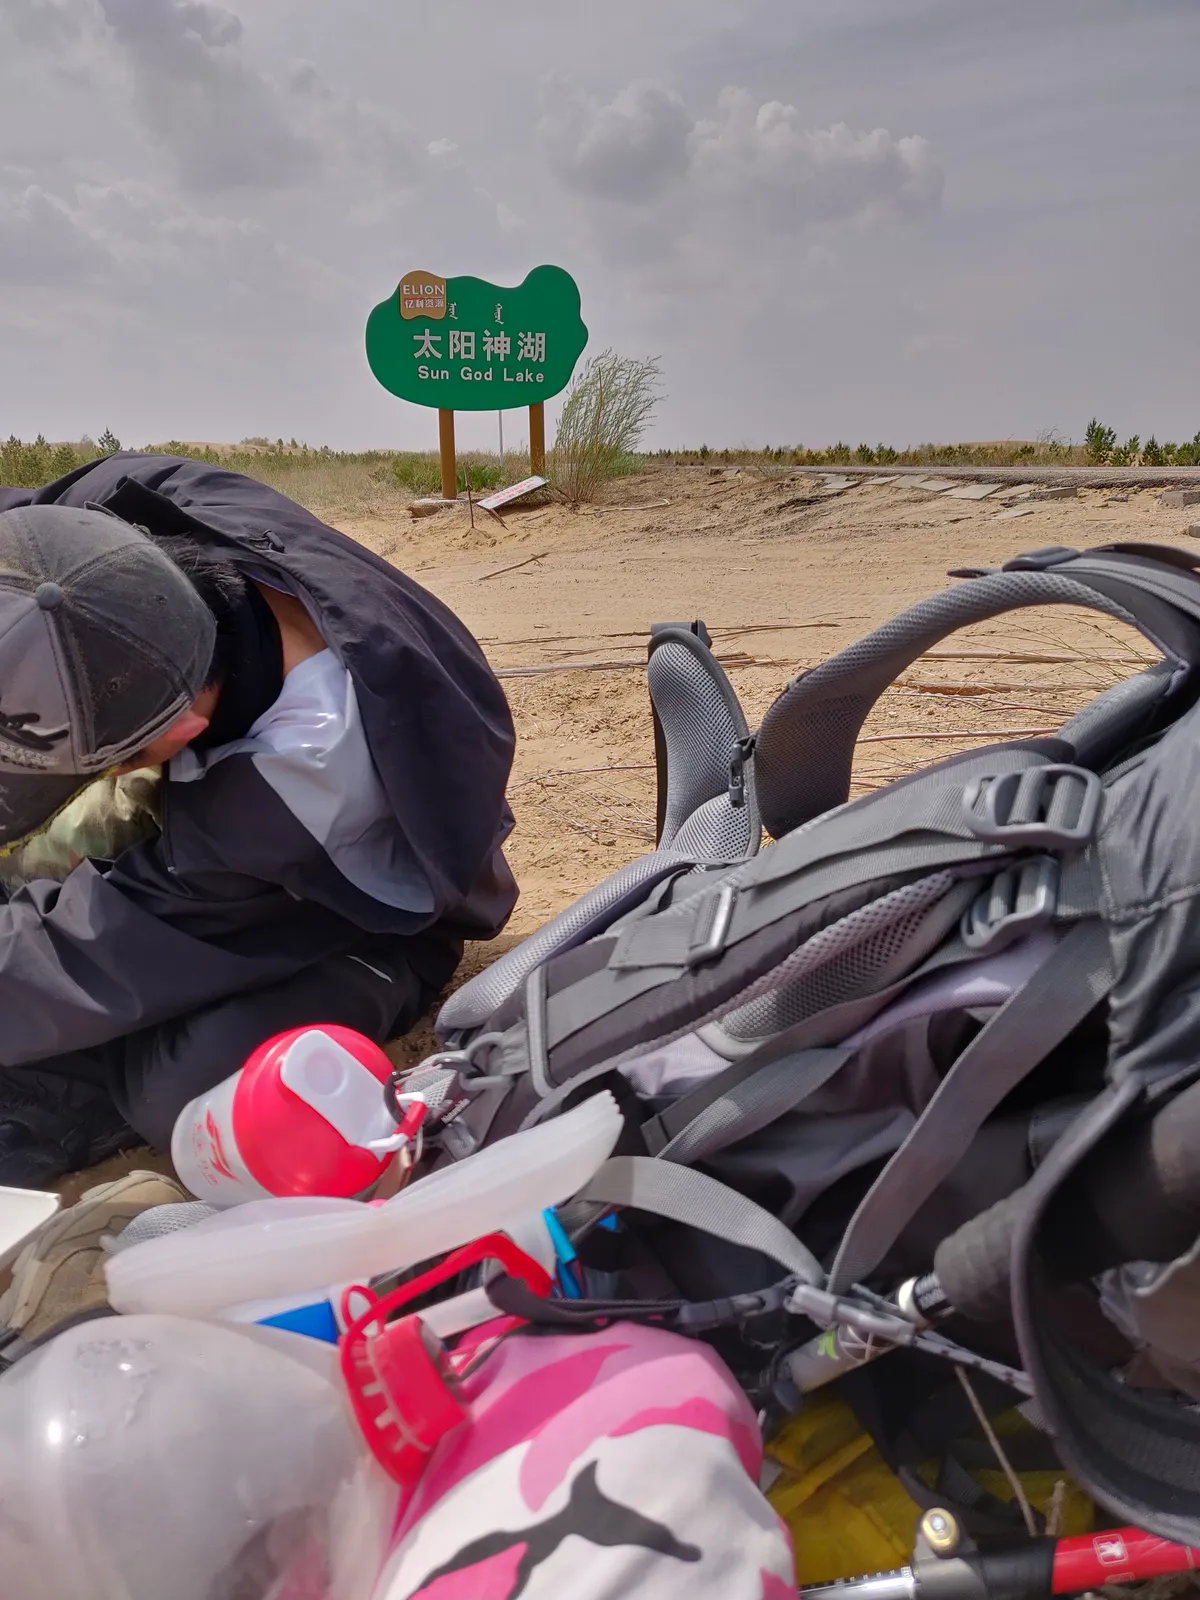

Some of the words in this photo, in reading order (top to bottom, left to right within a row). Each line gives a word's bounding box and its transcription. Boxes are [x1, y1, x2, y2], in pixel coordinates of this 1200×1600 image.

[403, 284, 444, 295] ELION
[413, 328, 546, 363] 太阳神湖
[418, 365, 449, 380] Sun
[460, 366, 493, 381] God
[503, 367, 544, 383] Lake
